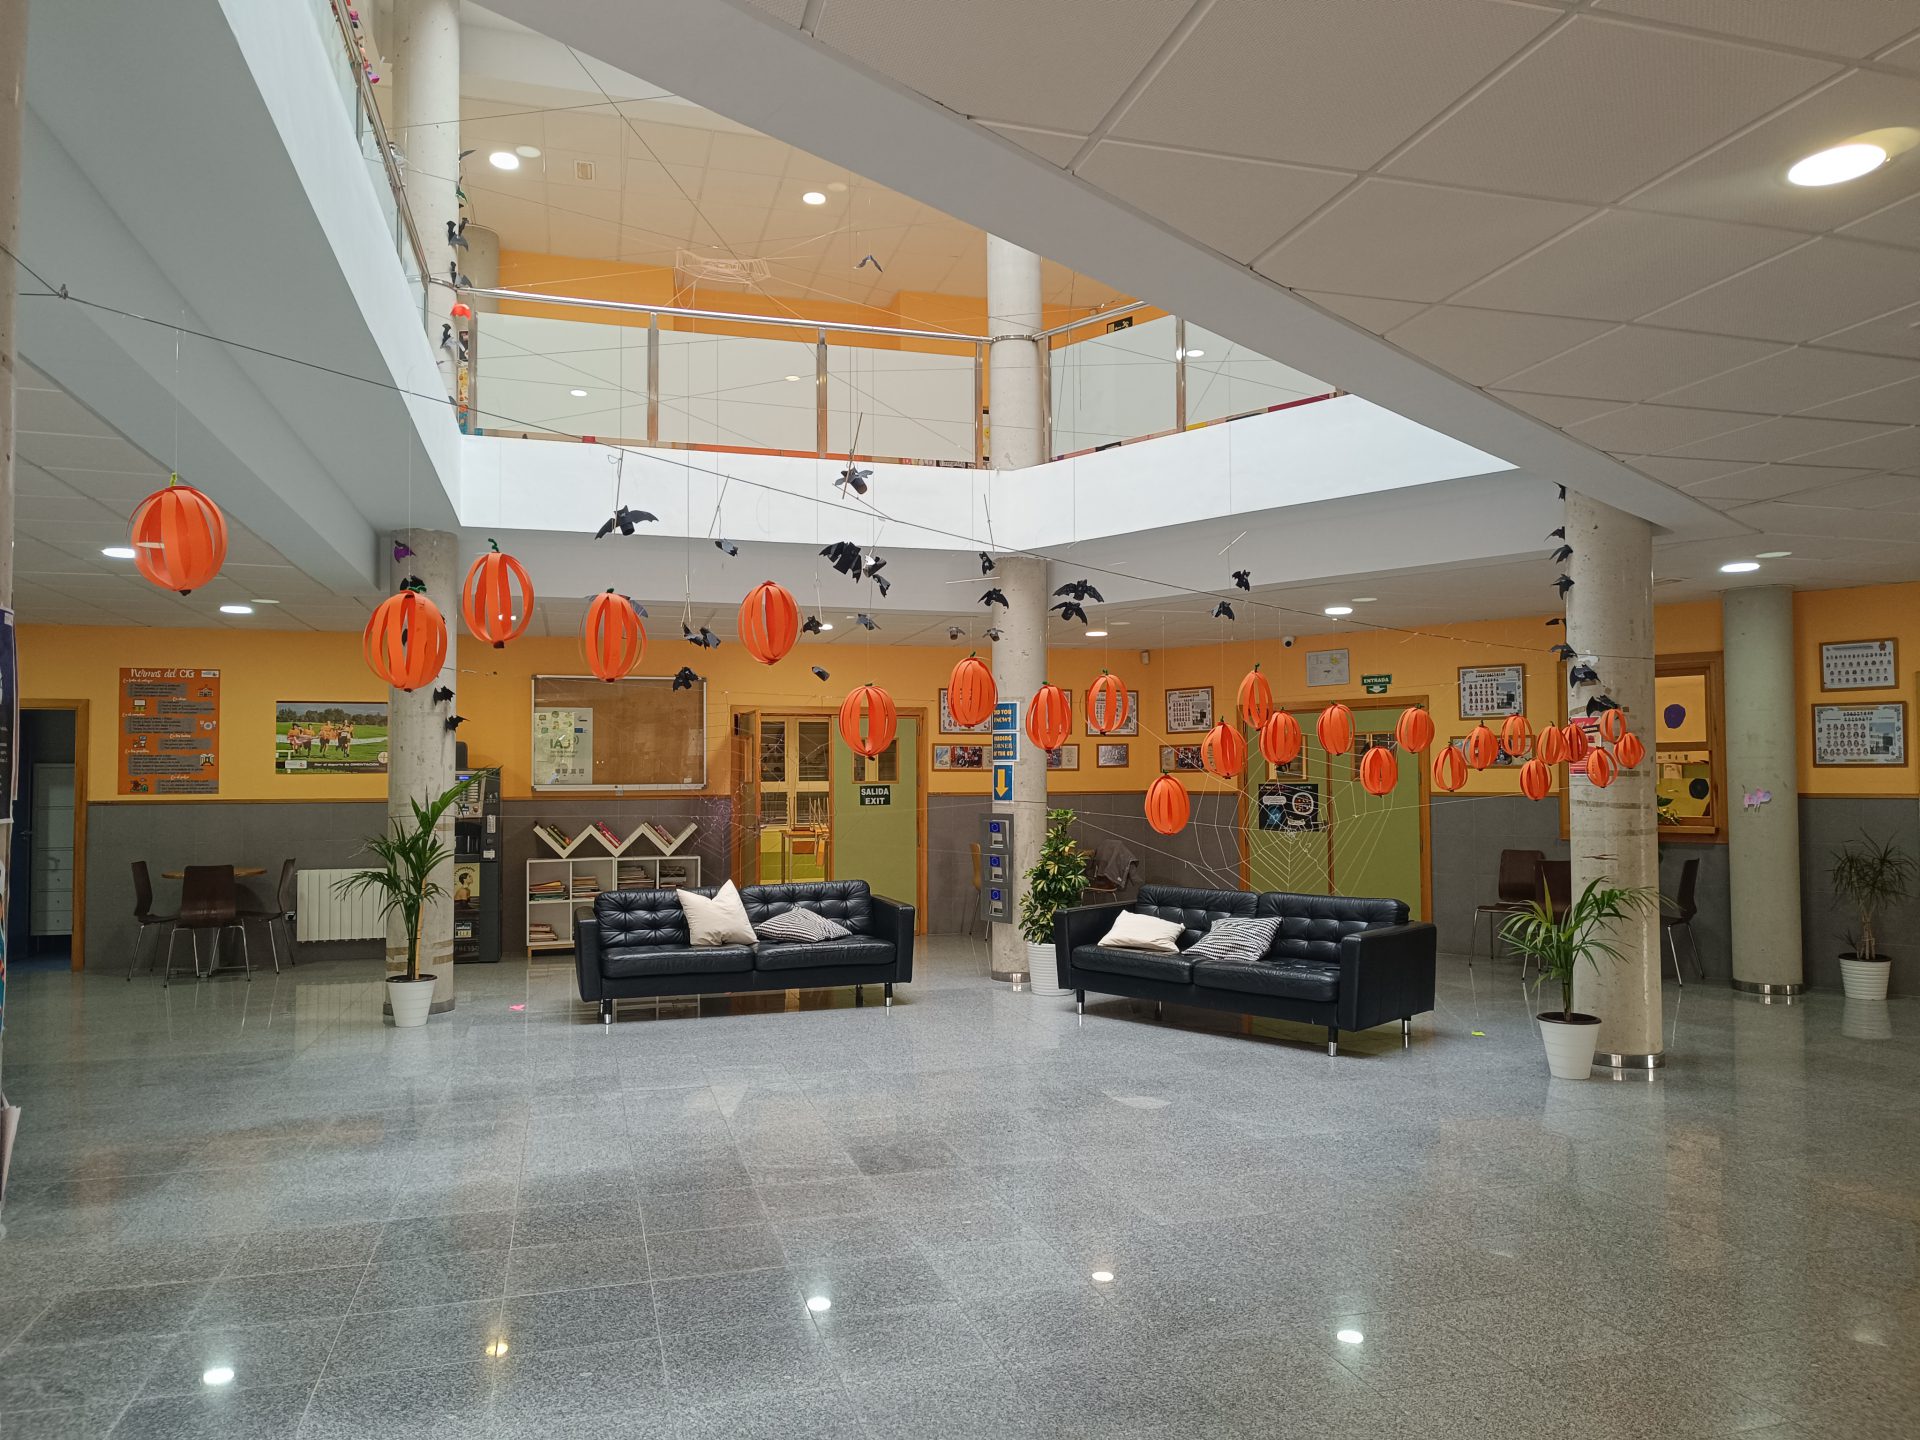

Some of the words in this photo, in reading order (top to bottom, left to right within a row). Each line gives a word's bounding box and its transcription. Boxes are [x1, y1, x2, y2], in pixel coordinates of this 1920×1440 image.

[131, 668, 161, 678] Normas
[164, 668, 176, 678] del
[861, 787, 889, 796] SALIDA
[865, 797, 885, 805] EXIT
